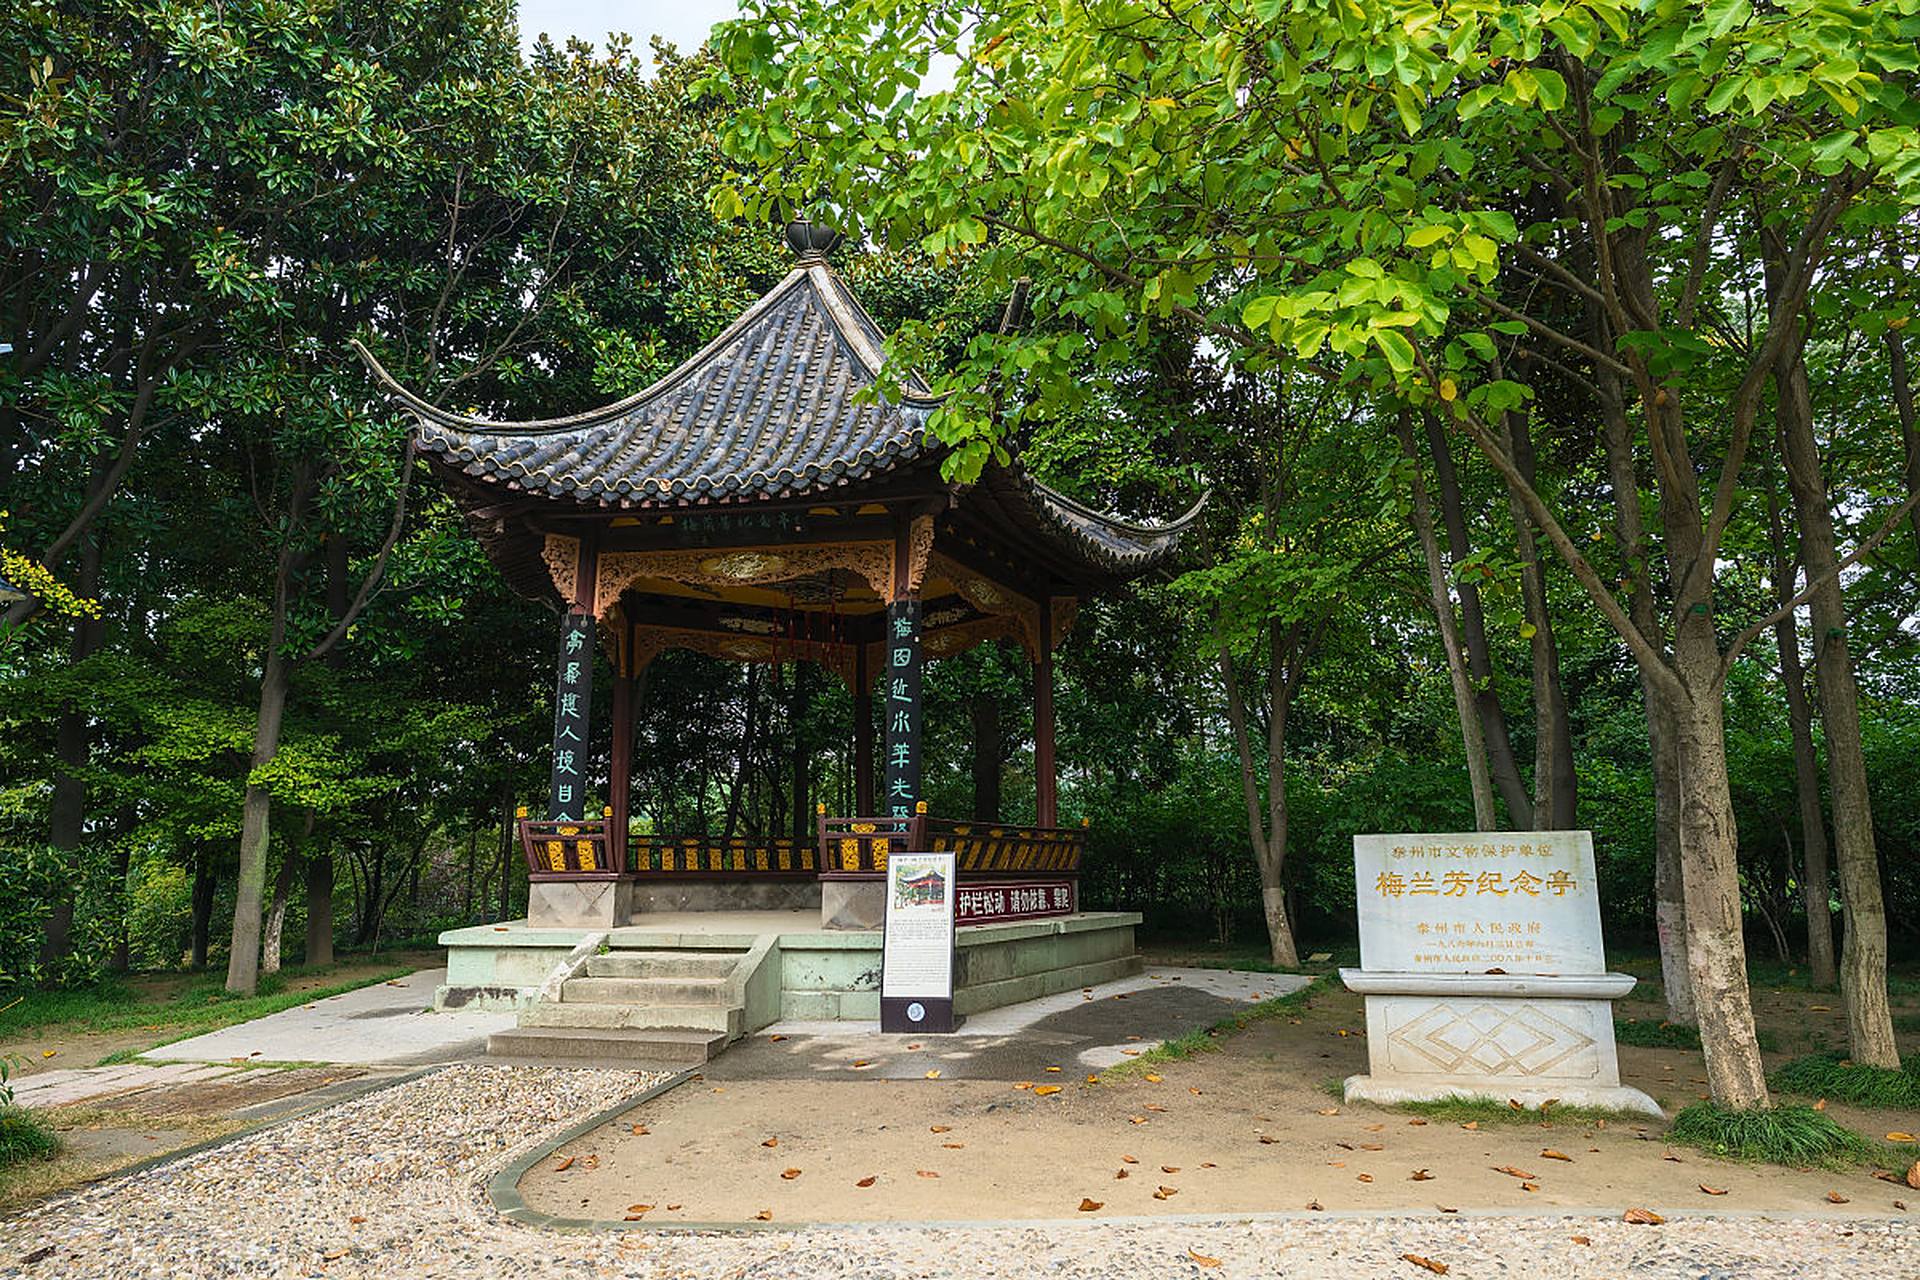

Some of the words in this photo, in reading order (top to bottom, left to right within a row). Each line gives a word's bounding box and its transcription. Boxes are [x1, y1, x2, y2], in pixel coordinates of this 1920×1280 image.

[1391, 843, 1554, 860] 泰州市文物保护单位
[1375, 870, 1577, 898] 梅兰芳纪念亭
[959, 890, 1006, 916] 护栏松动
[1416, 921, 1542, 935] 泰州市人民政府
